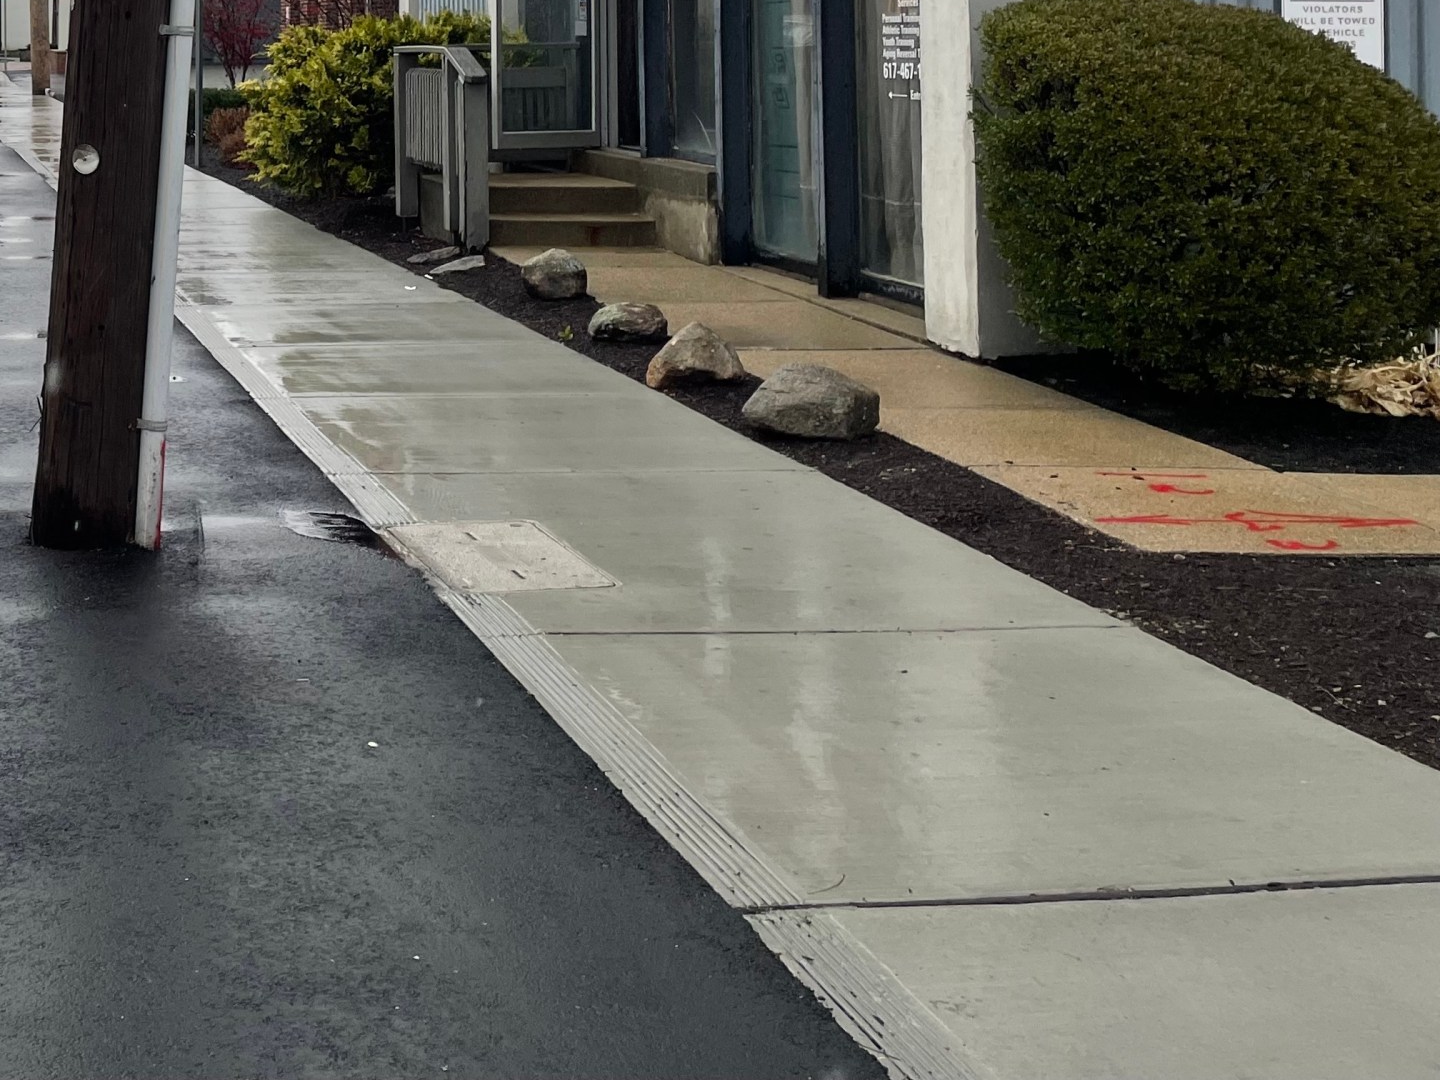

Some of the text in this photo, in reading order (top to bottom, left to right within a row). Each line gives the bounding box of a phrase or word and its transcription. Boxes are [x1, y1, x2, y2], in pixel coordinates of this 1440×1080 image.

[1302, 5, 1363, 13] VIOLATORS
[1291, 17, 1375, 25] WILL BE TOWED
[883, 62, 920, 79] 617-467-1
